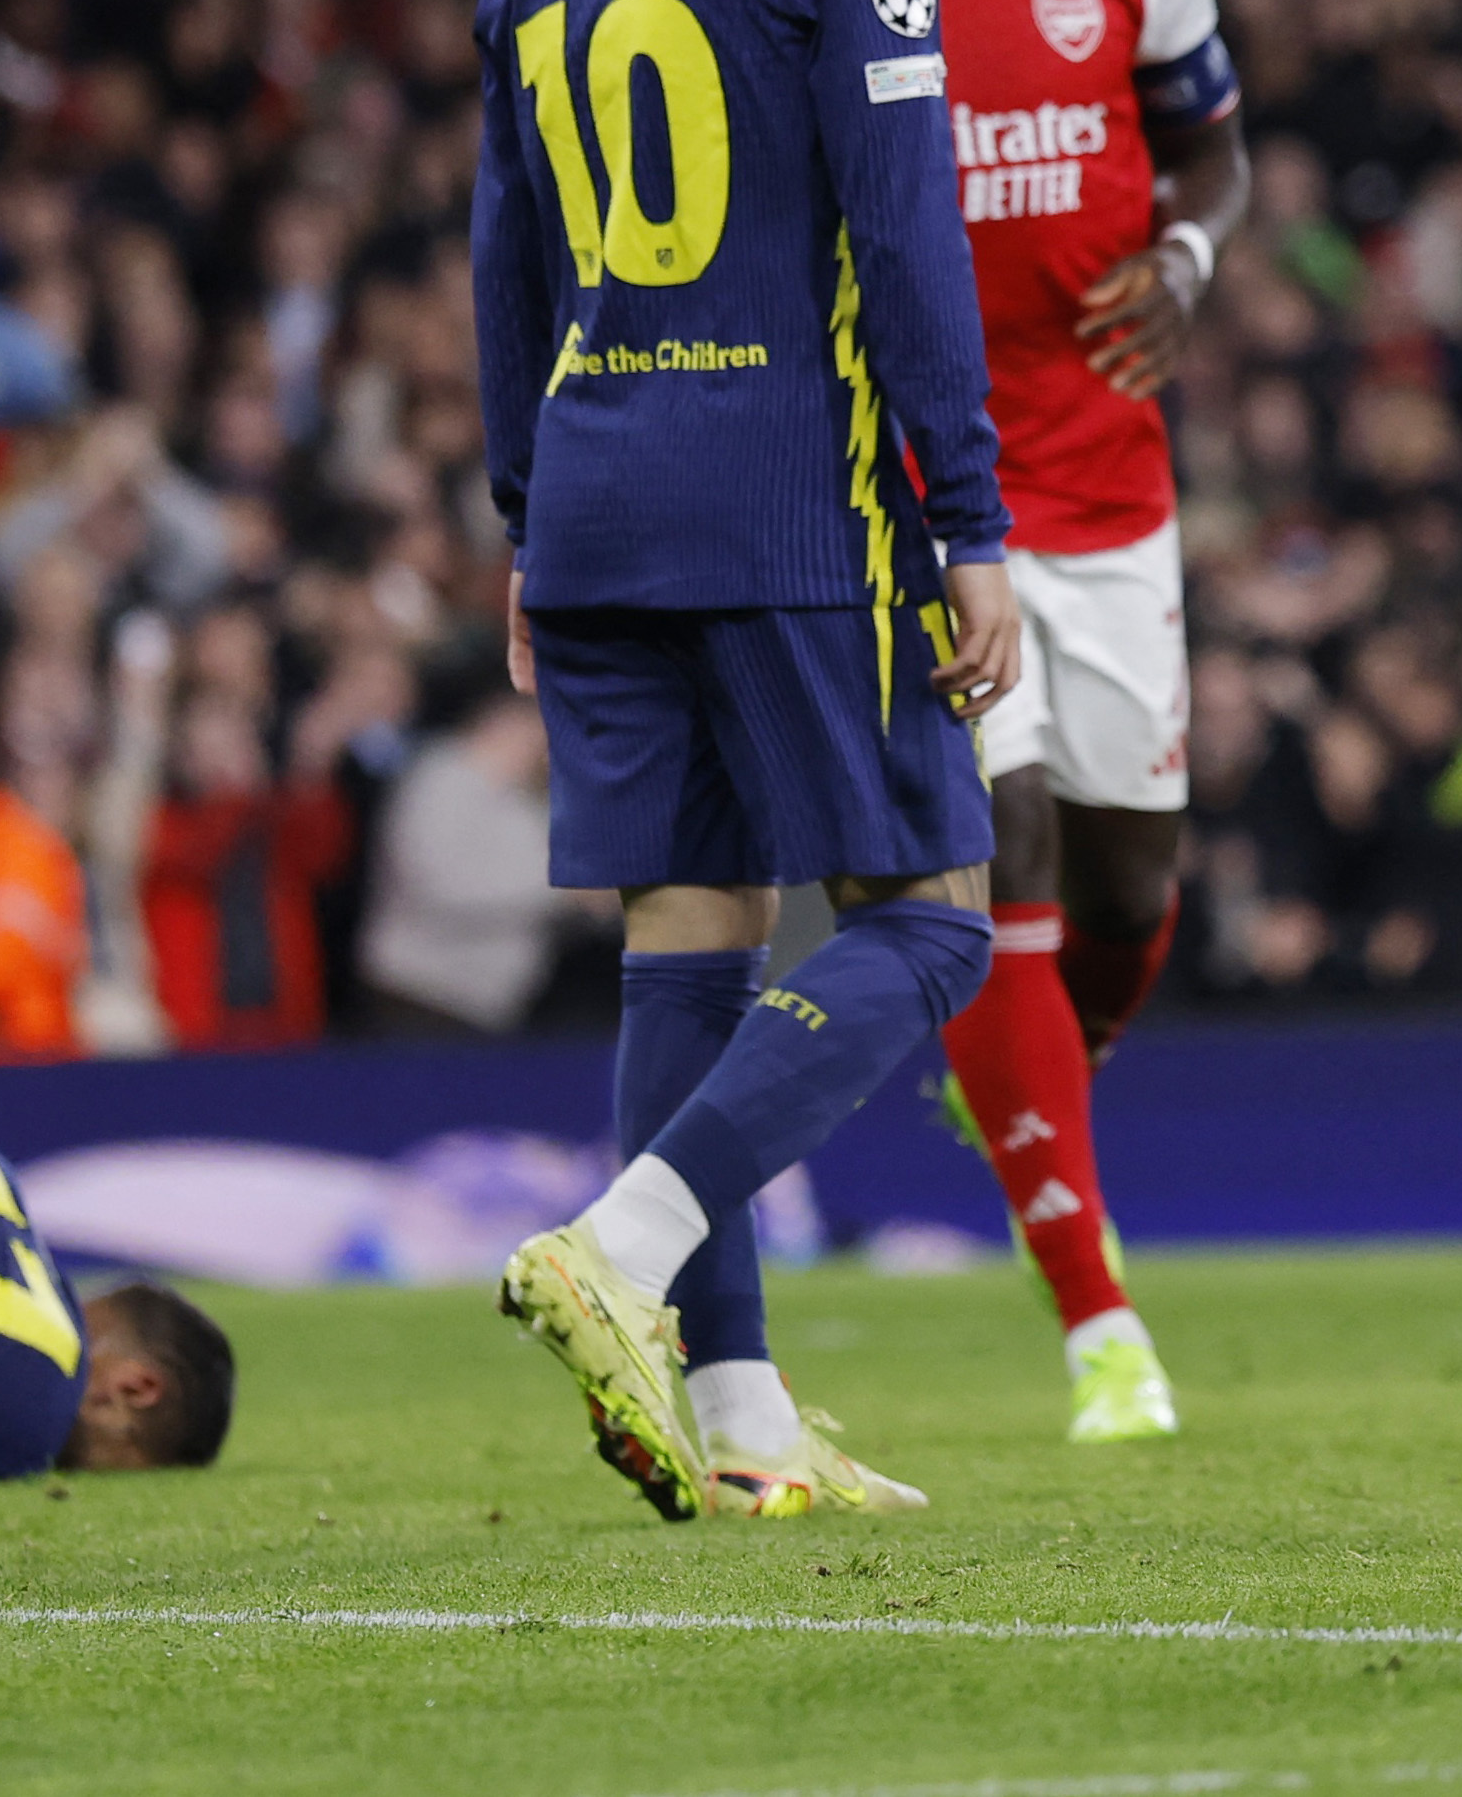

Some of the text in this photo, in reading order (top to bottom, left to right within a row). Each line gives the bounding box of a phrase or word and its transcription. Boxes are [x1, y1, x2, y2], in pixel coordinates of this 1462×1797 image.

[952, 100, 1107, 169] irates
[963, 159, 1082, 223] BETTER
[606, 344, 653, 375] the
